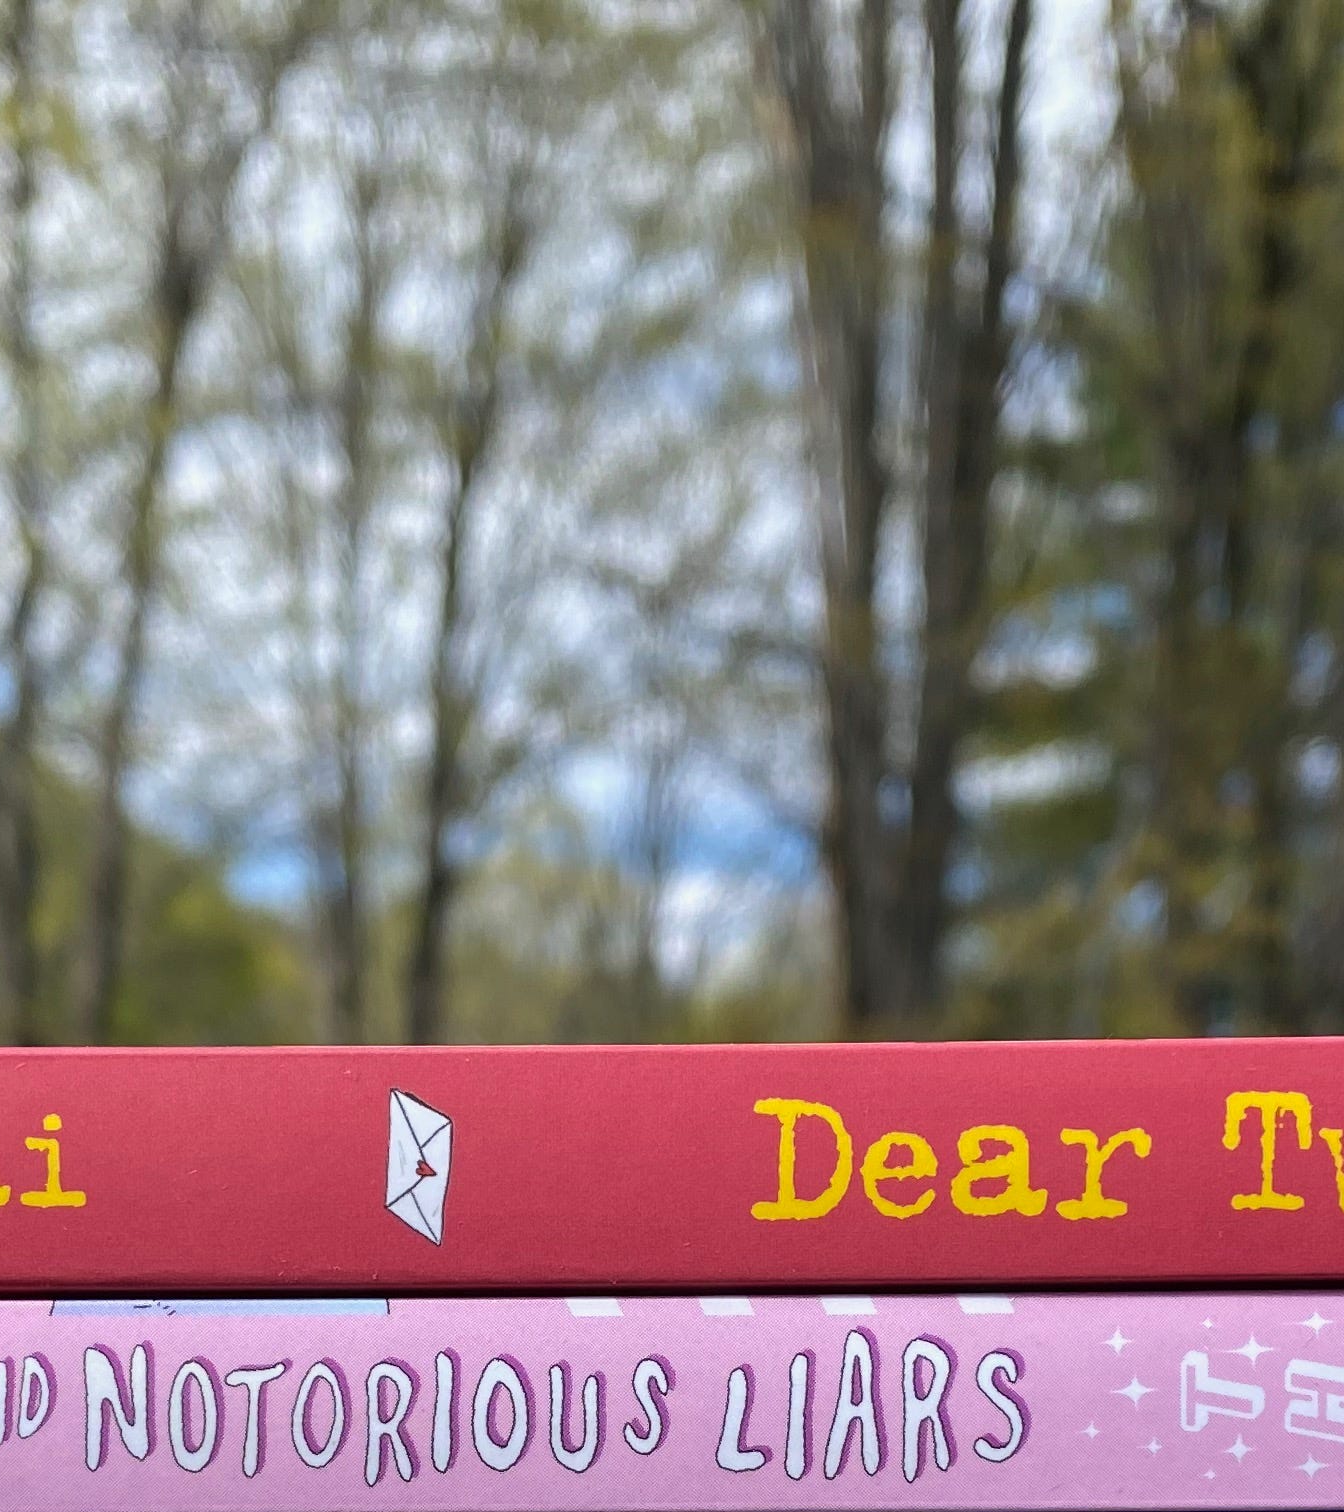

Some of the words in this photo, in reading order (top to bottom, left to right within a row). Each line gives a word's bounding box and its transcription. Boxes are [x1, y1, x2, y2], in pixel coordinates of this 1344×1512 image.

[751, 1097, 1152, 1221] Dear
[84, 1340, 676, 1486] NOTORIOUS
[715, 1326, 1032, 1482] LIARS
